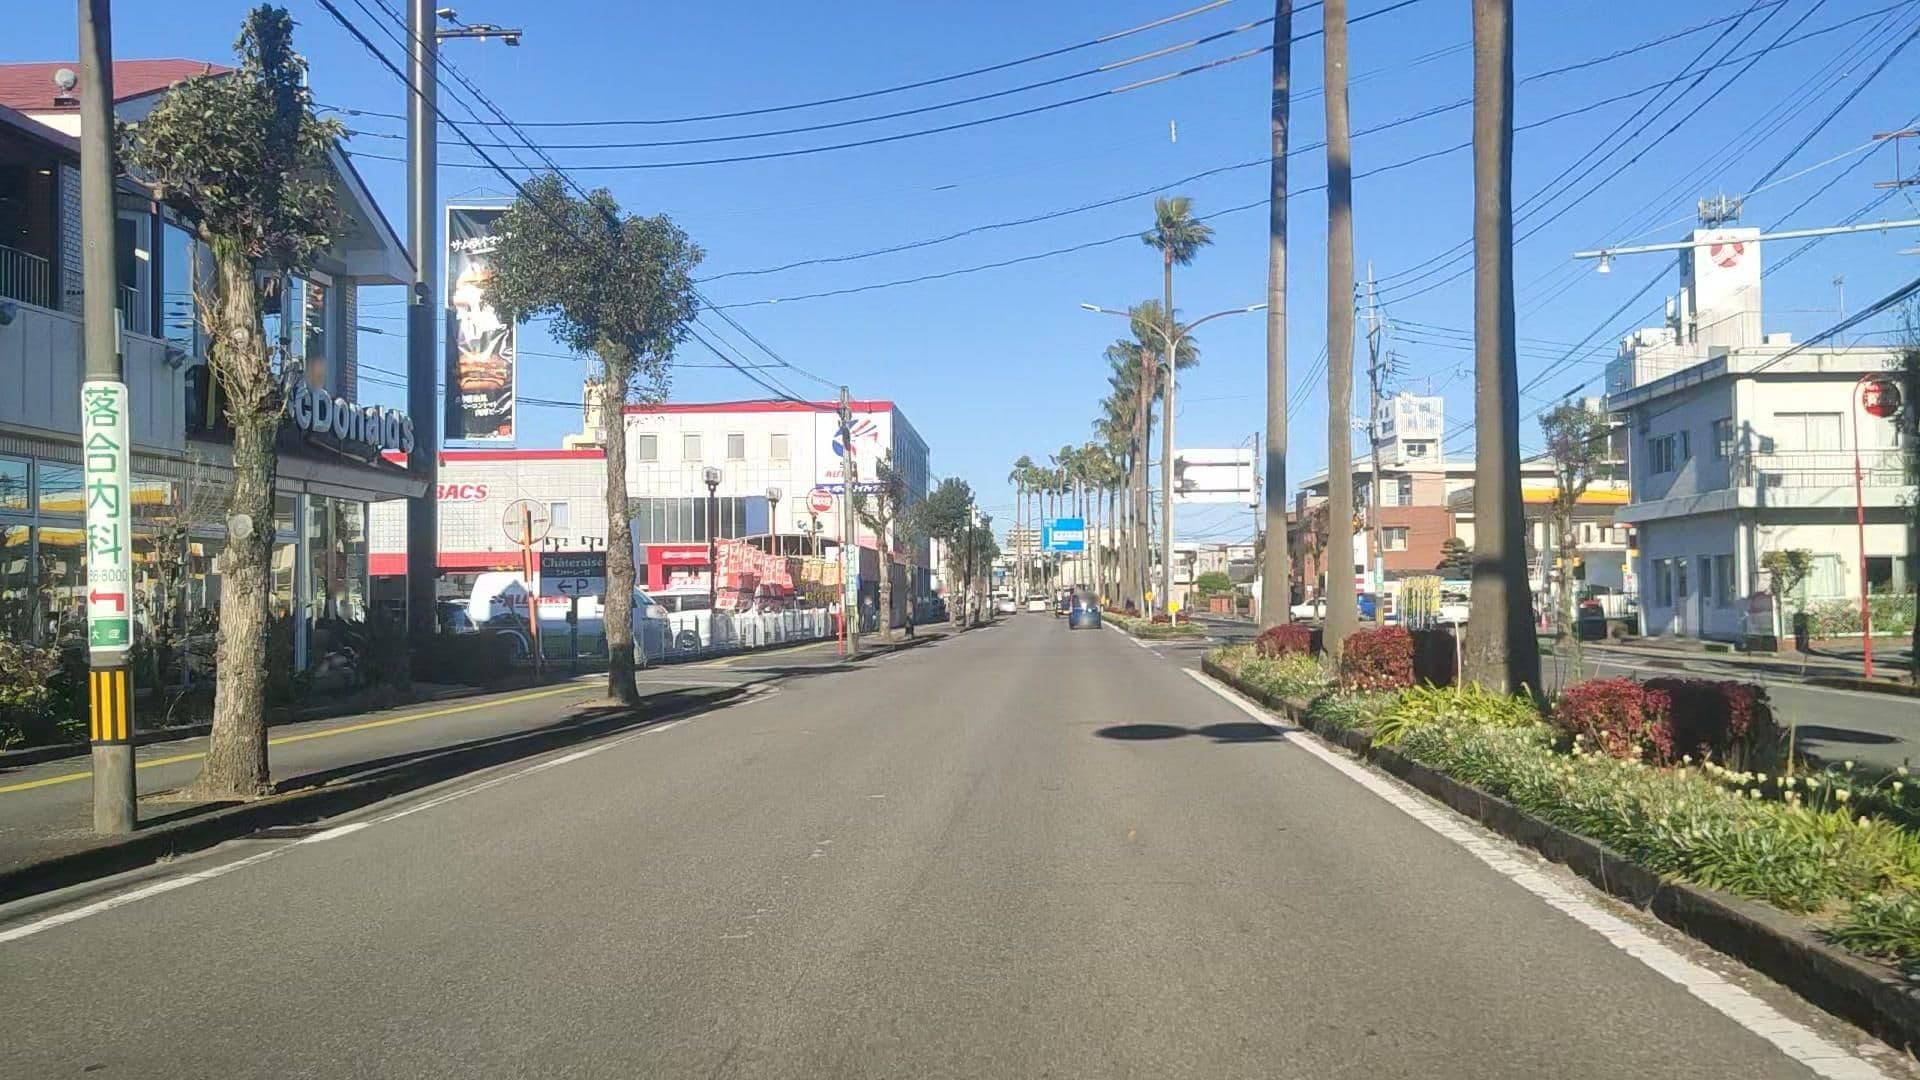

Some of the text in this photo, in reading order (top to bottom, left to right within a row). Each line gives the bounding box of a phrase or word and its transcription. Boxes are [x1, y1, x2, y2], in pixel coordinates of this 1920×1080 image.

[84, 387, 121, 565] 落合内科
[288, 381, 415, 455] cDonald's
